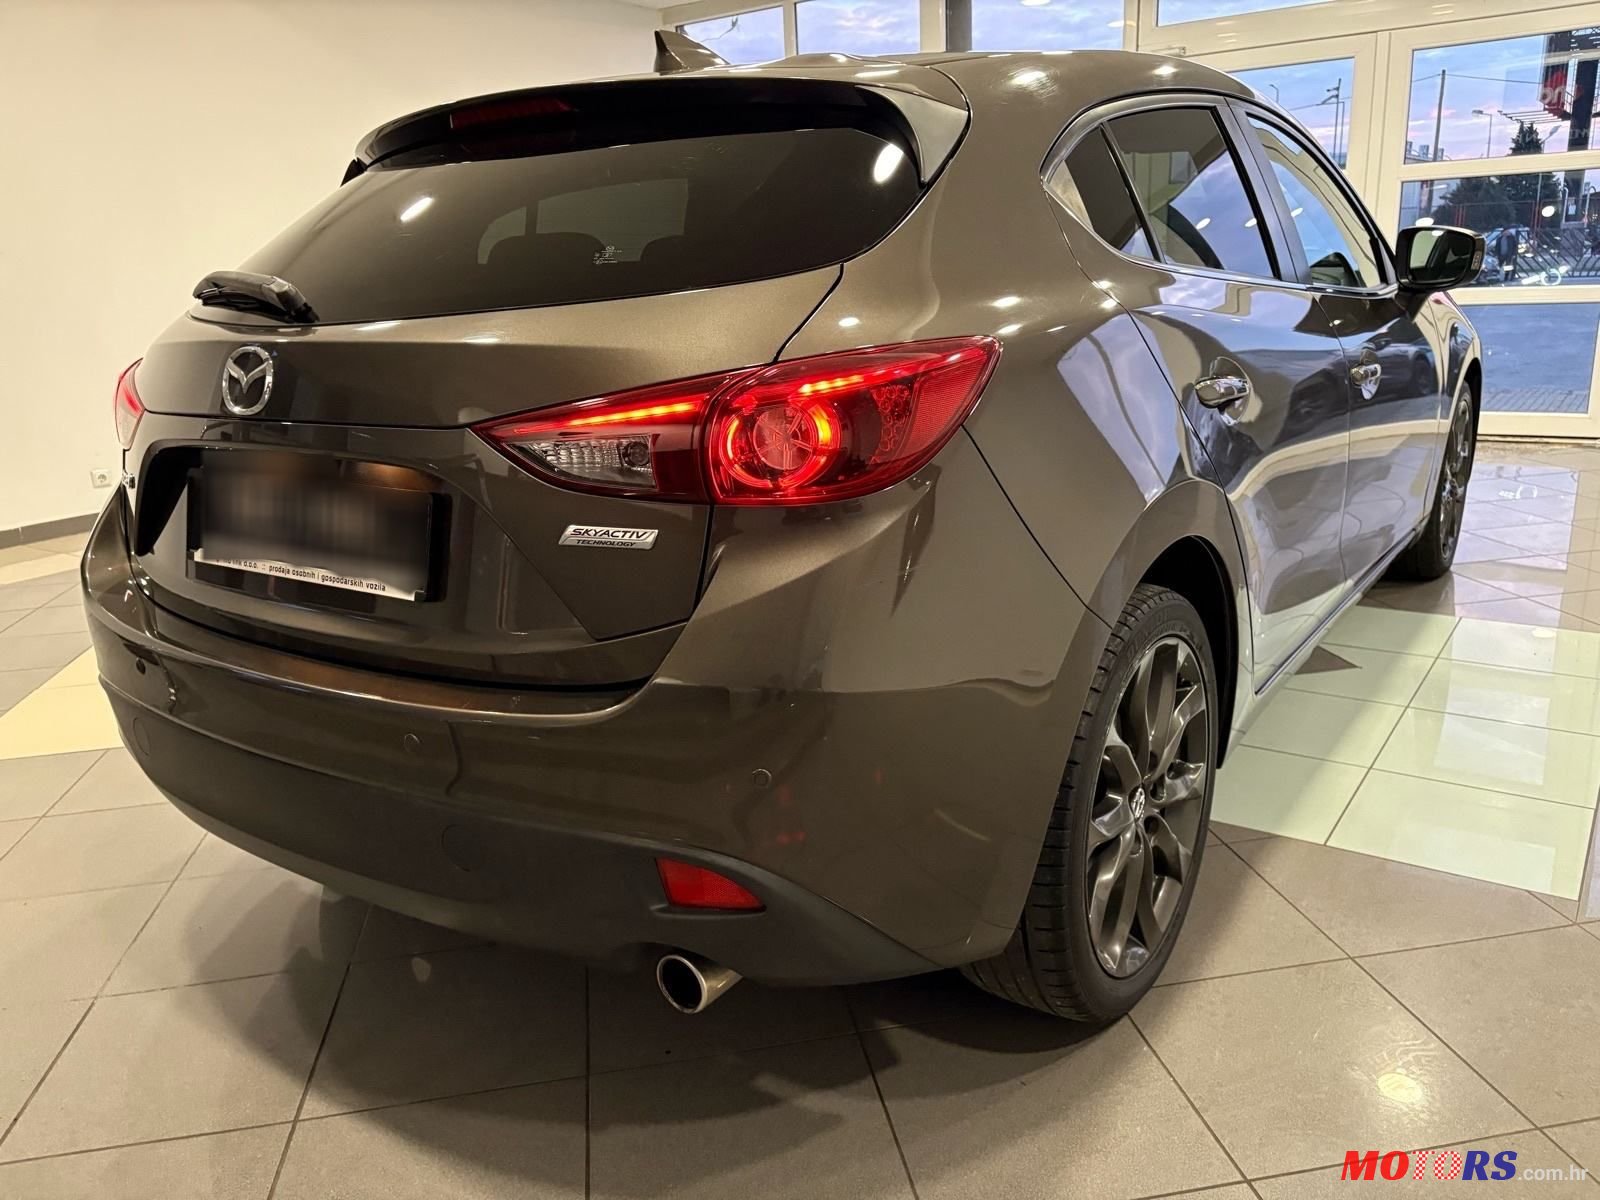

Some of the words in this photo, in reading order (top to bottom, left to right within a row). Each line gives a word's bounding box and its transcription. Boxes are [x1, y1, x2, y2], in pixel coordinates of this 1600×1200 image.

[570, 528, 648, 539] SKYACTIV
[576, 539, 637, 547] TECHNOLOGY
[269, 564, 290, 575] prodaja
[291, 569, 316, 579] osobnih
[321, 573, 364, 588] gospodarskih
[366, 582, 386, 592] vozila
